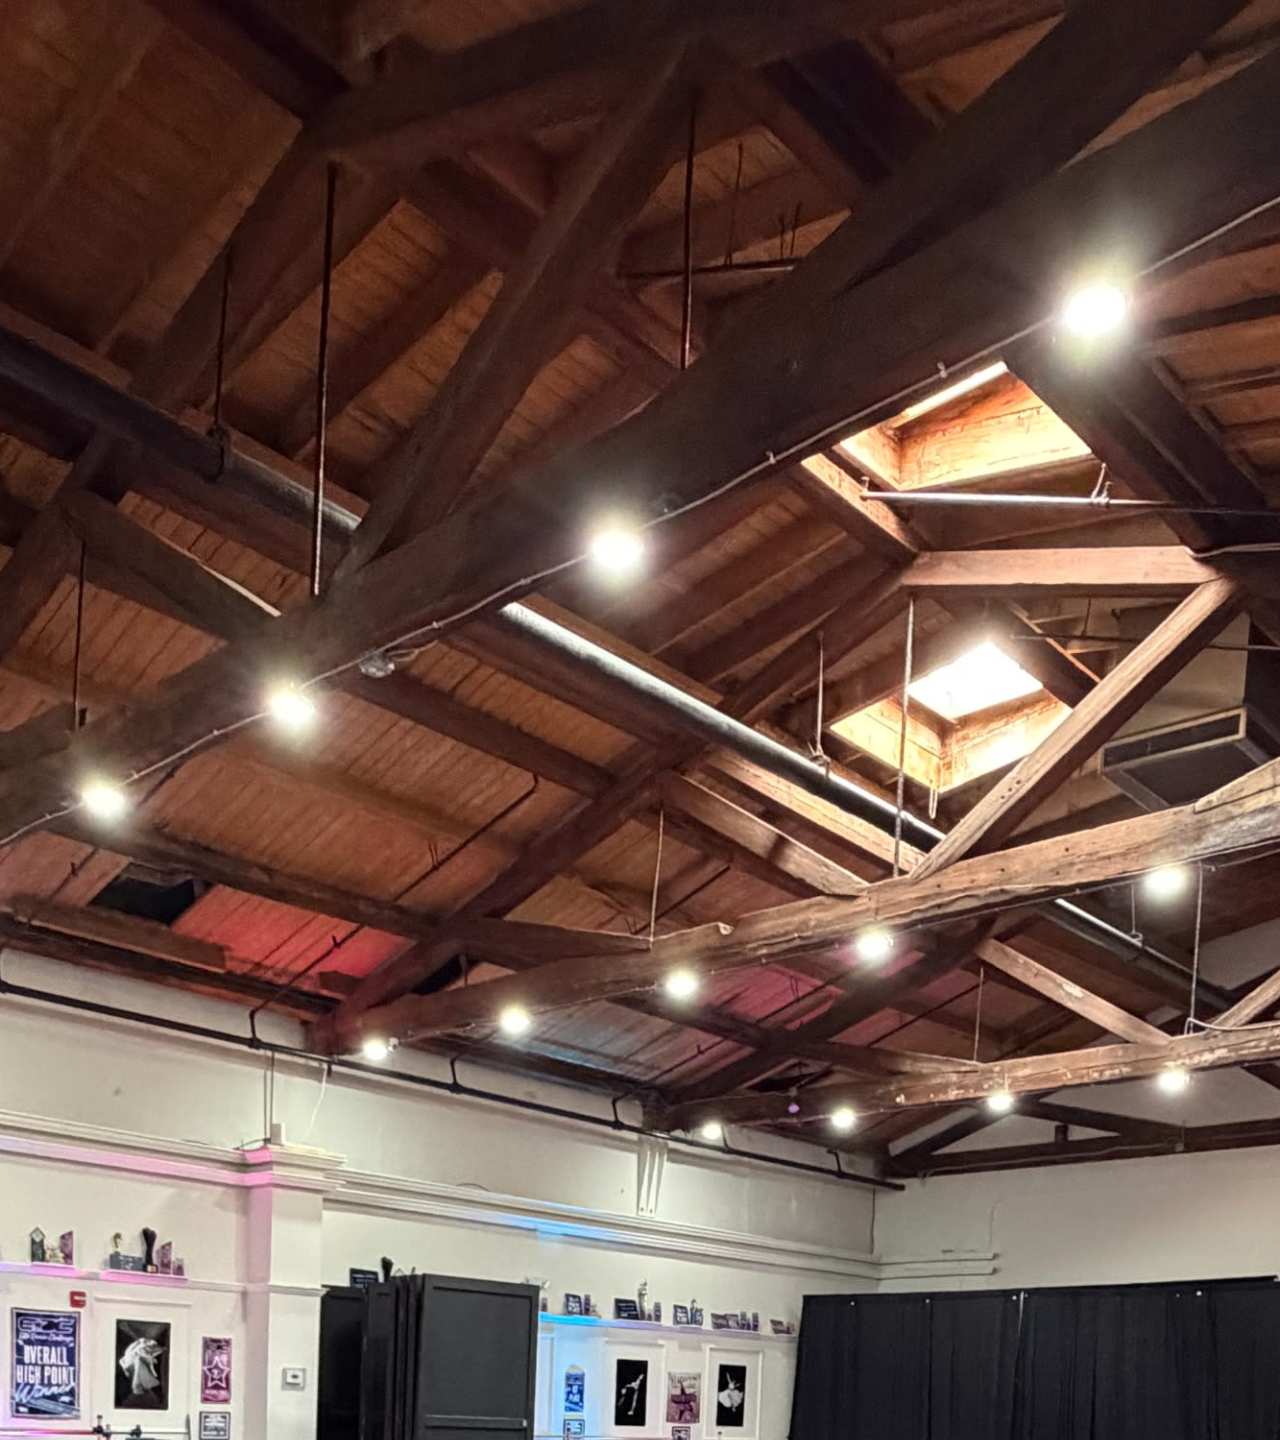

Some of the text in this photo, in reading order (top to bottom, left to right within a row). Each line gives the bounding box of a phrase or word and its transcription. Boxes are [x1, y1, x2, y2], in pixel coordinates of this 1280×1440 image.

[23, 1345, 69, 1366] OVERALL
[16, 1364, 76, 1385] HIGH POINT
